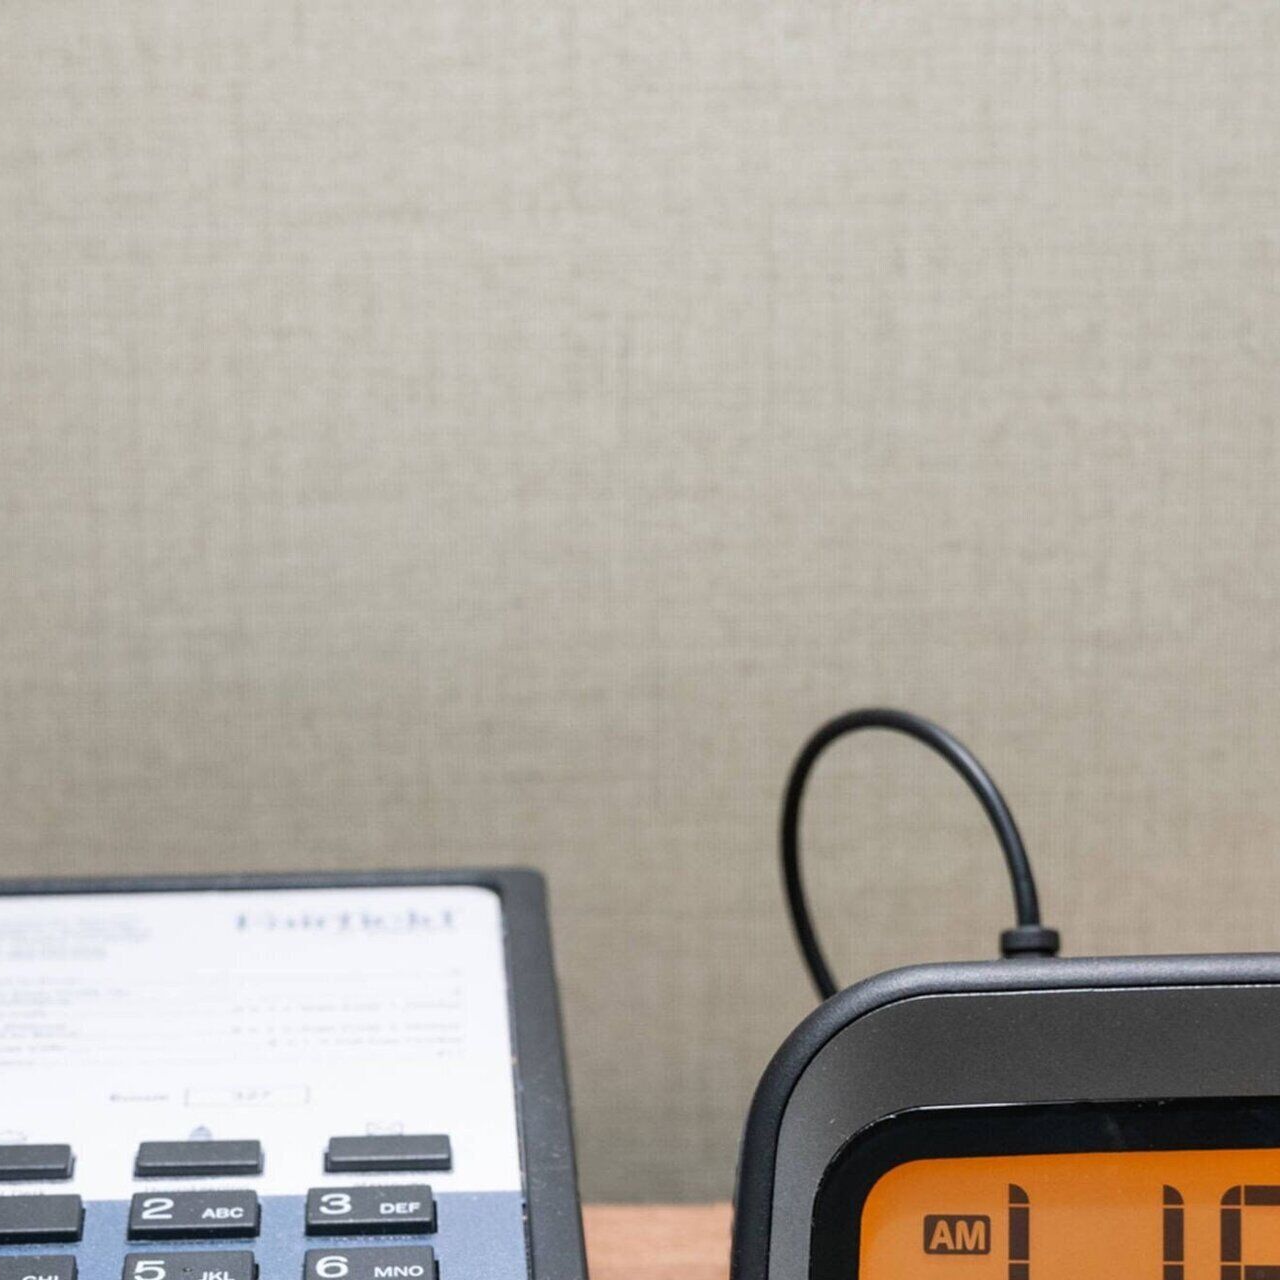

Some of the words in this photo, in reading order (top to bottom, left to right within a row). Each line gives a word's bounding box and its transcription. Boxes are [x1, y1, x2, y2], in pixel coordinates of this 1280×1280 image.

[141, 1197, 175, 1220] 2
[201, 1206, 244, 1219] ABC
[319, 1193, 352, 1215] 3
[379, 1201, 421, 1215] DEF
[928, 1218, 986, 1251] AM
[315, 1255, 349, 1279] 6
[374, 1265, 425, 1278] MNO
